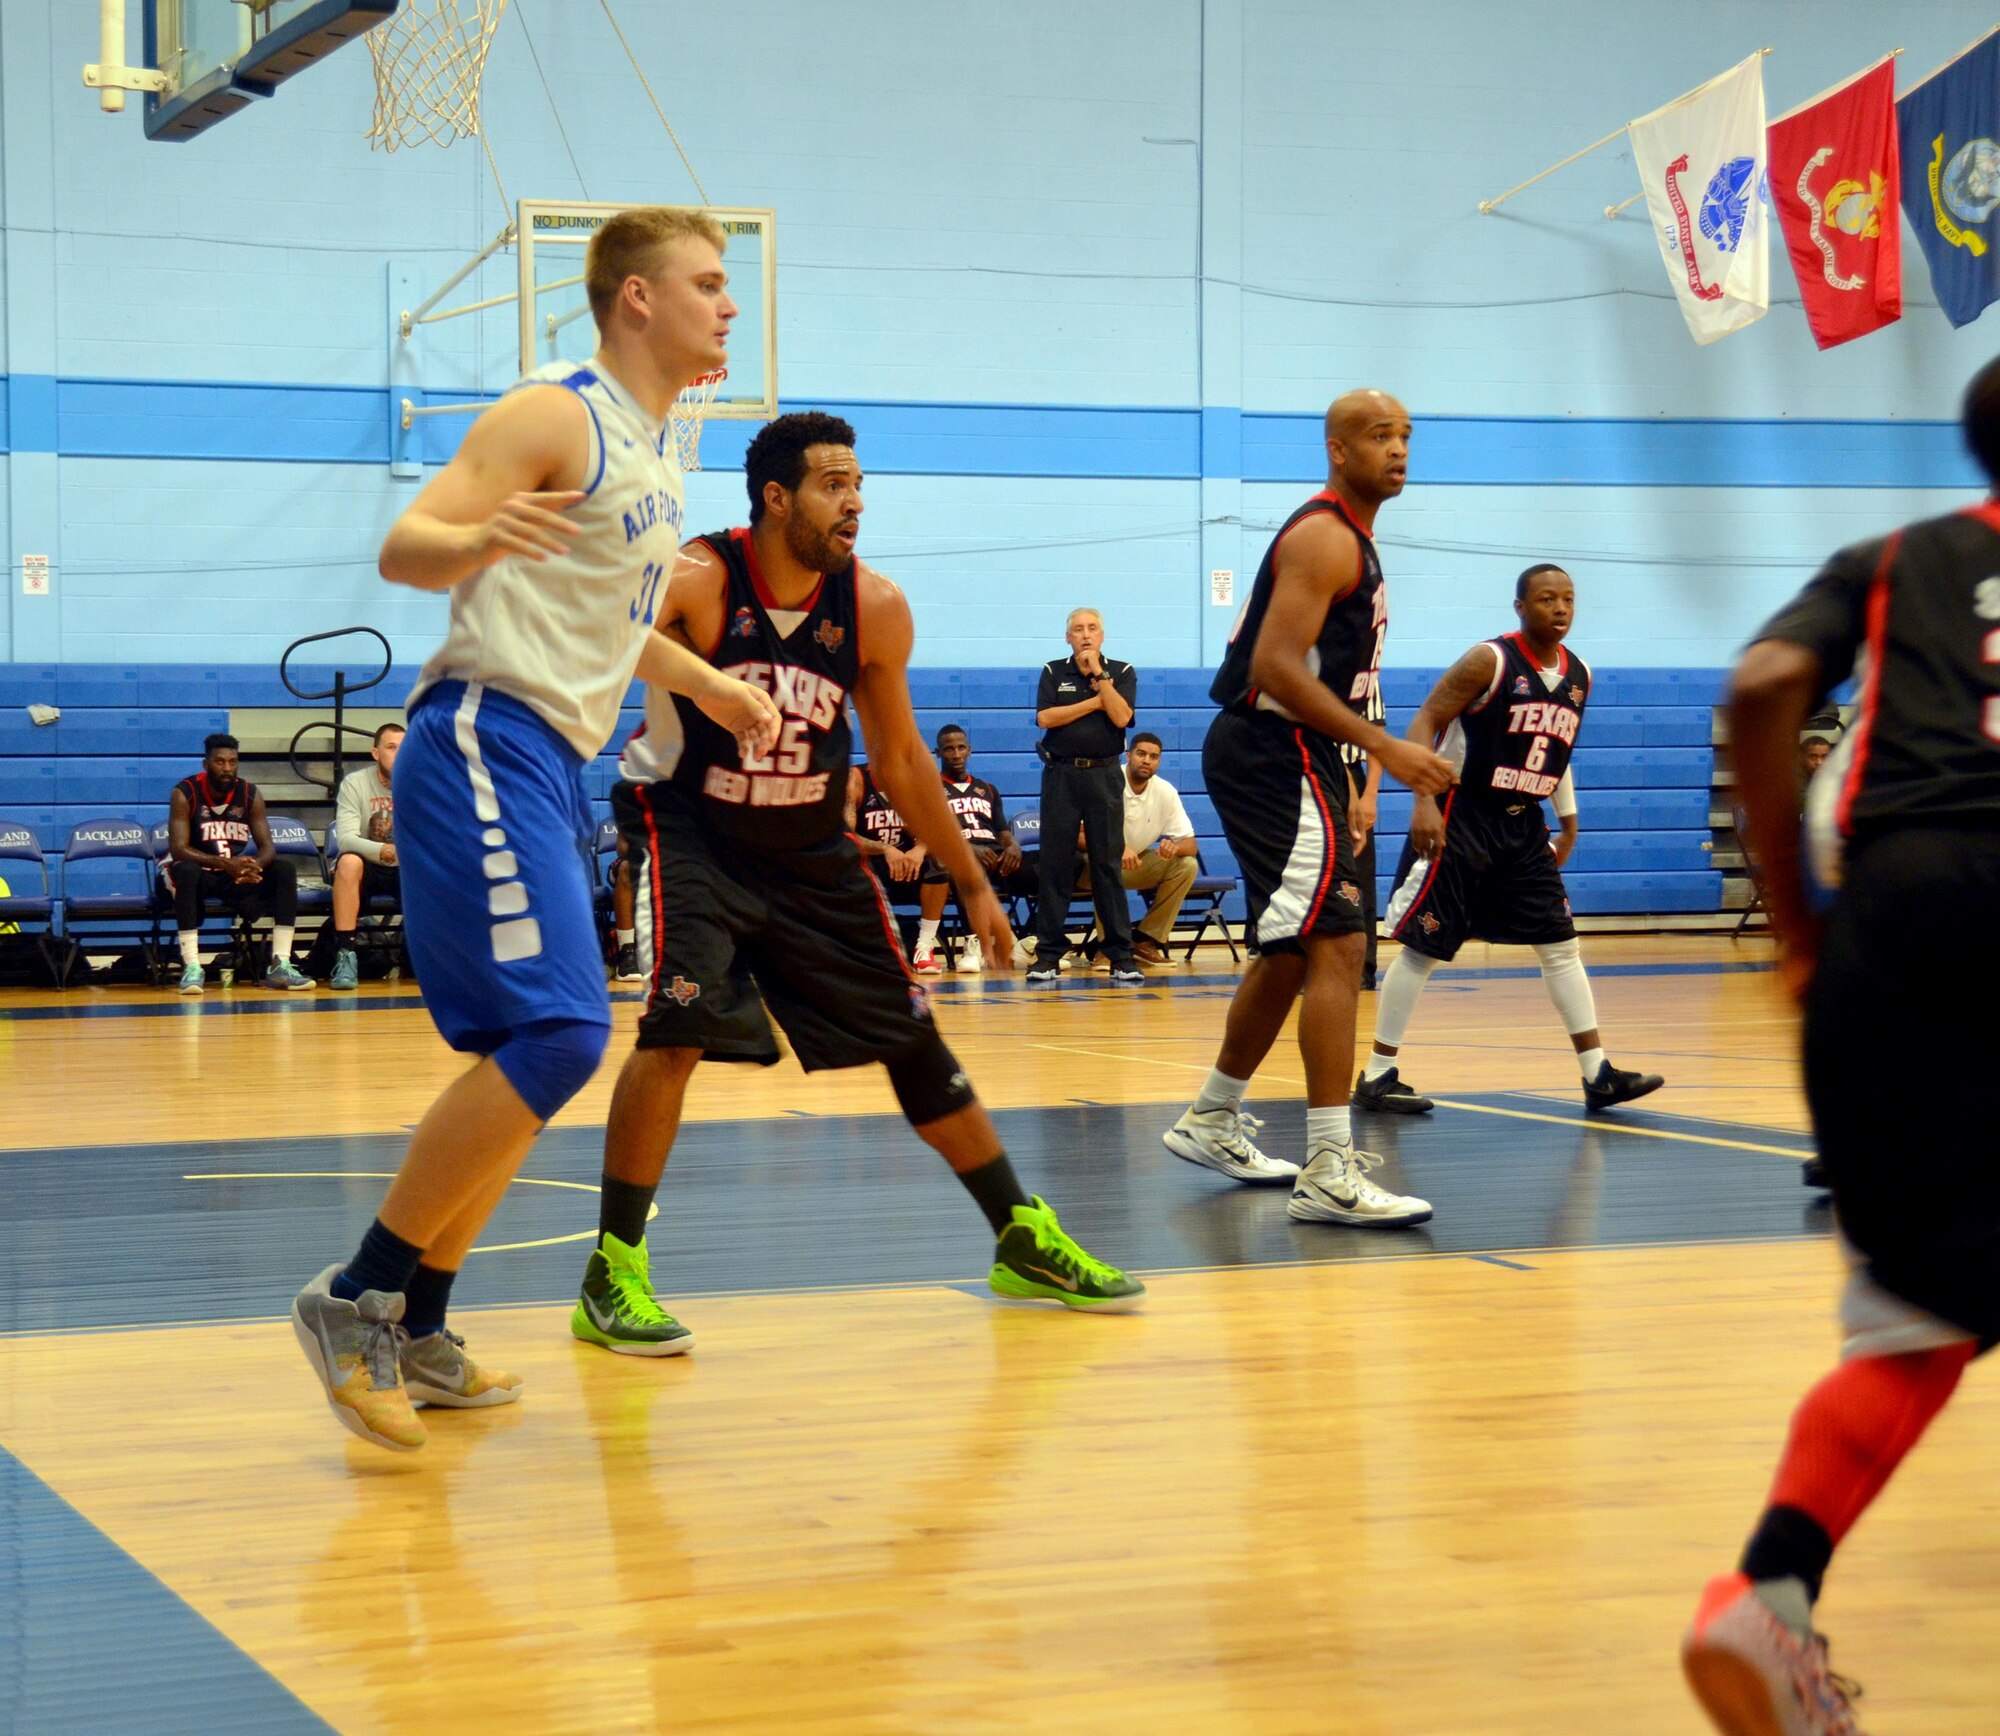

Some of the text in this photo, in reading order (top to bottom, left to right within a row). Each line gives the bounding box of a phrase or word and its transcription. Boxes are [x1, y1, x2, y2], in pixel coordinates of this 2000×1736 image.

[533, 215, 552, 228] NO
[737, 223, 759, 234] RIM
[1667, 175, 1702, 291] UNITED STATES ARMY
[1941, 223, 1961, 242] NAVY
[1665, 225, 1678, 250] 1775
[1815, 235, 1833, 266] MARINE
[623, 488, 684, 544] AIR FORC
[629, 562, 664, 625] 31
[1508, 702, 1580, 748] TEXAS
[1525, 735, 1550, 772] 6
[1491, 766, 1519, 789] RED
[201, 820, 249, 843] TEXAS
[964, 813, 979, 829] 4
[75, 830, 142, 841] LACKLAND
[217, 840, 231, 858] 5
